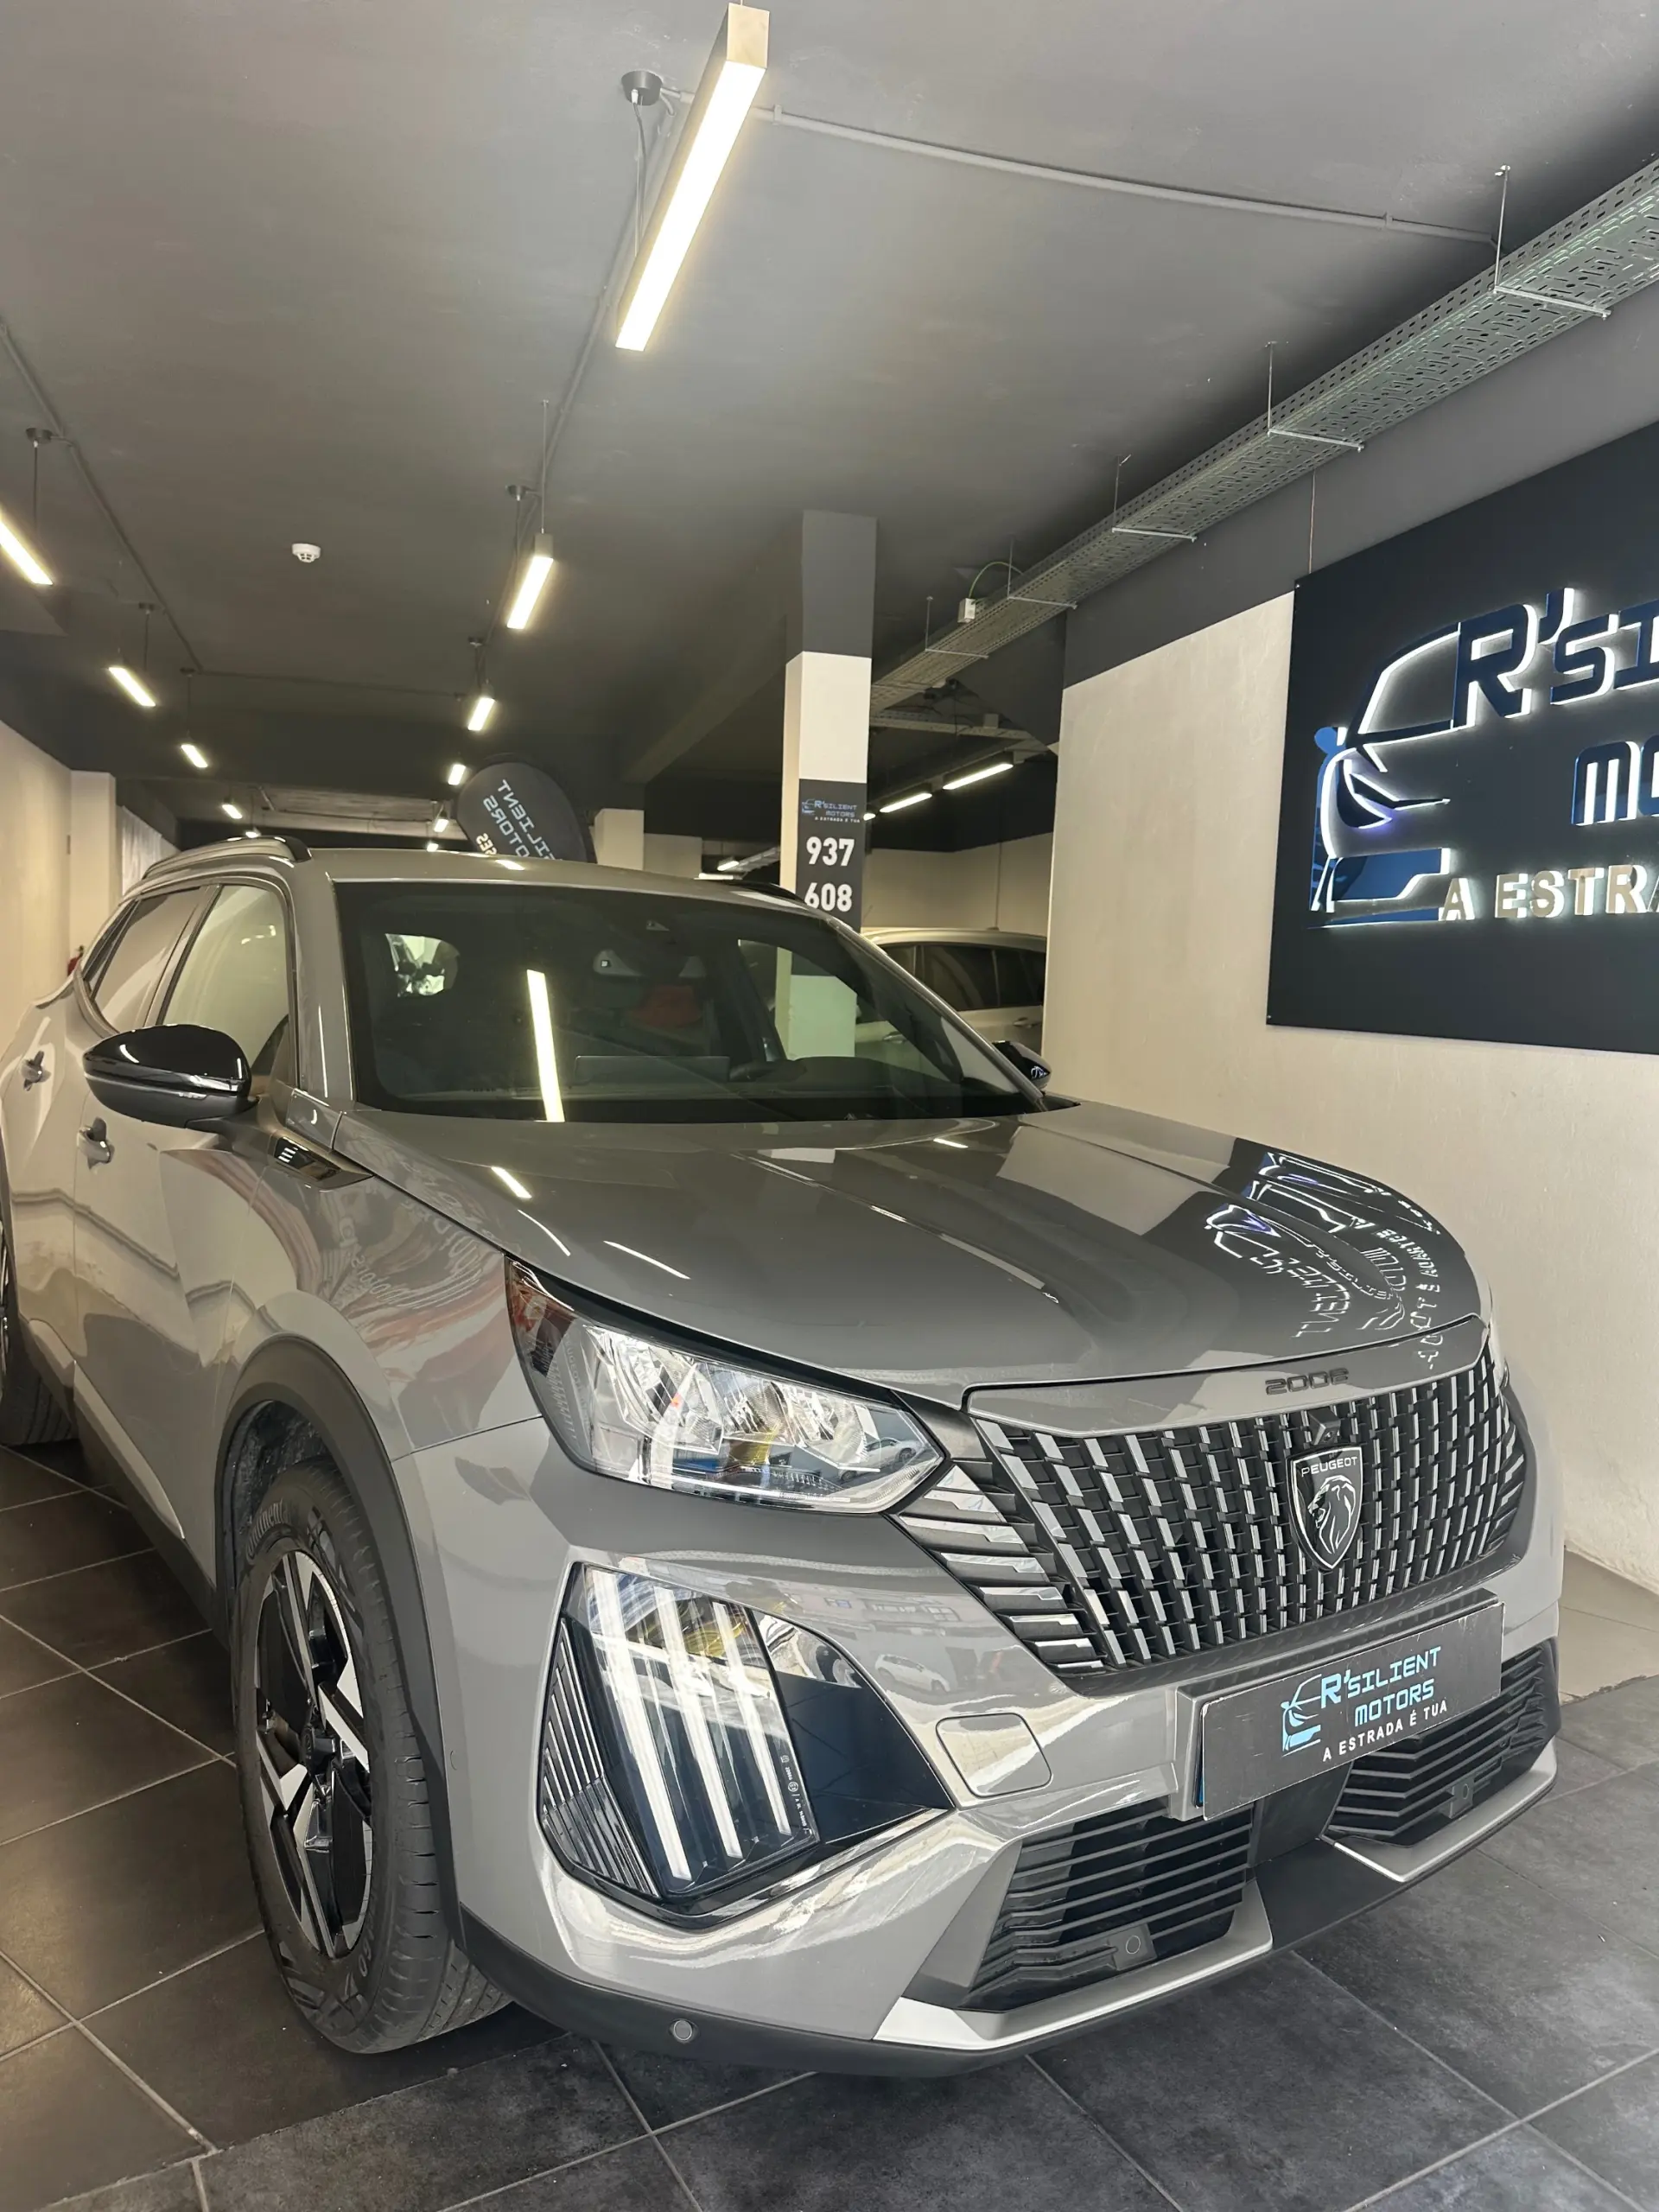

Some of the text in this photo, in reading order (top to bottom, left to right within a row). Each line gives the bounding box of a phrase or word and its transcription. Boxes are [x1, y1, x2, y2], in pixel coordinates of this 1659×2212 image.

[806, 836, 855, 866] 937
[804, 882, 852, 912] 608
[1441, 864, 1659, 921] A ESTR
[1265, 1368, 1350, 1395] 2008
[1300, 1456, 1358, 1478] PEUGEOT
[1321, 1646, 1441, 1709] R'SILIENT
[1355, 1678, 1434, 1726] MOTORS
[1323, 1700, 1447, 1762] A ESTRADA É TUA
